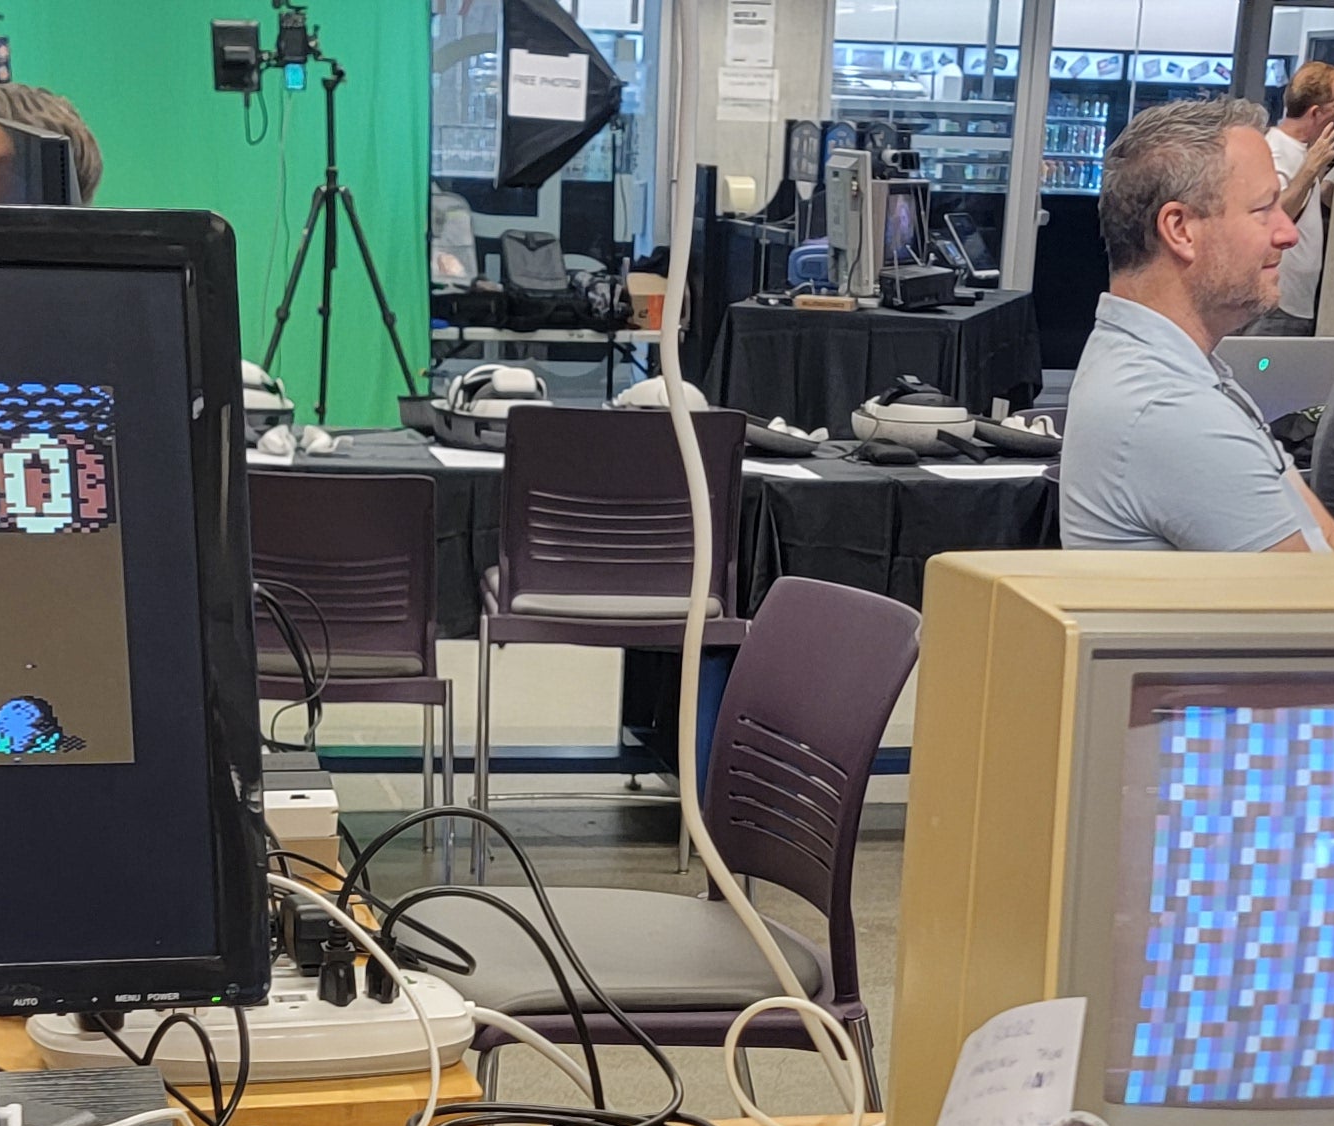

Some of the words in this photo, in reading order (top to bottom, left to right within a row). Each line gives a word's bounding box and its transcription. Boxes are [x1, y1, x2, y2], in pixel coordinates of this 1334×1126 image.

[115, 994, 141, 1003] MENU
[147, 992, 180, 1002] POWER
[13, 998, 39, 1006] AUTO
